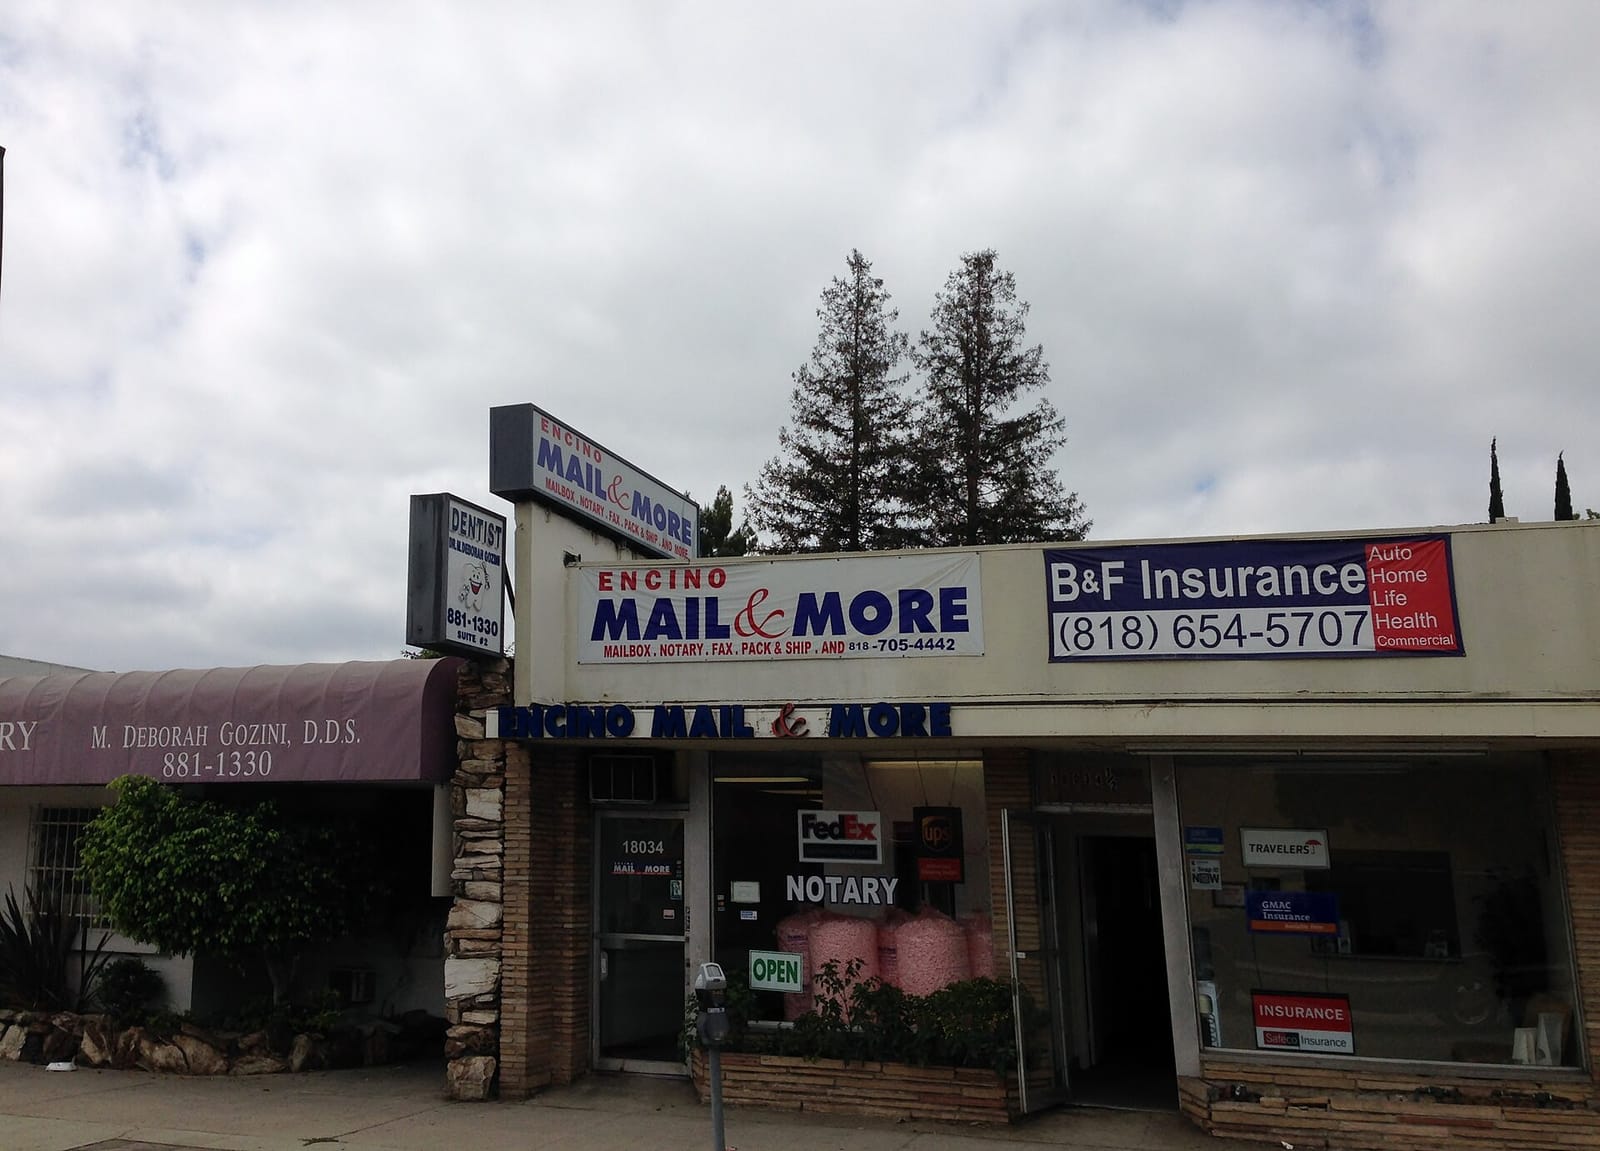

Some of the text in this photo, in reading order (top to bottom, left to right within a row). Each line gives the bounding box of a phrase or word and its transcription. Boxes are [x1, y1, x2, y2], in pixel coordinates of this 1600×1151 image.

[540, 417, 602, 463] ENCINO
[537, 437, 692, 547] MAIL & MORE
[545, 477, 575, 503] MAILBOX
[580, 495, 604, 518] NOTARY
[624, 518, 640, 536] PACK
[646, 529, 659, 544] SHIP
[662, 538, 673, 551] AND
[451, 507, 502, 549] DENTIST
[1368, 546, 1412, 562] Auto
[598, 567, 727, 592] ENCINO
[1050, 559, 1367, 602] B&F Insurance
[1371, 568, 1427, 584] Home
[1373, 590, 1407, 606] Life
[447, 607, 498, 637] 881-1330
[591, 586, 969, 641] MAIL & MORE
[1375, 611, 1438, 629] Health
[457, 630, 488, 647] SUITE #2
[1059, 610, 1369, 651] (818) 654-5707
[1377, 634, 1454, 647] Commercial
[603, 644, 651, 658] MAILBOX
[660, 642, 704, 657] NOTARY
[712, 642, 733, 656] FAX
[741, 641, 771, 655] PACK
[774, 641, 782, 654] &
[785, 641, 811, 654] SHIP
[821, 641, 845, 654] AND
[498, 702, 953, 738] ENCINO MAIL & MORE
[91, 719, 361, 749] M. DEBORAH GOZINI, D.D.S.
[163, 750, 272, 778] 881-1330
[801, 814, 877, 841] FedEx
[622, 840, 664, 854] 18034
[1248, 843, 1310, 855] TRAVELERS
[614, 865, 670, 873] MAIL MORE
[786, 875, 899, 904] NOTARY
[1262, 900, 1291, 909] GMAC
[1262, 911, 1311, 921] Insurance
[753, 957, 799, 984] OPEN
[1259, 1004, 1345, 1021] INSURANCE
[1265, 1032, 1347, 1048] Safeco Insurance
